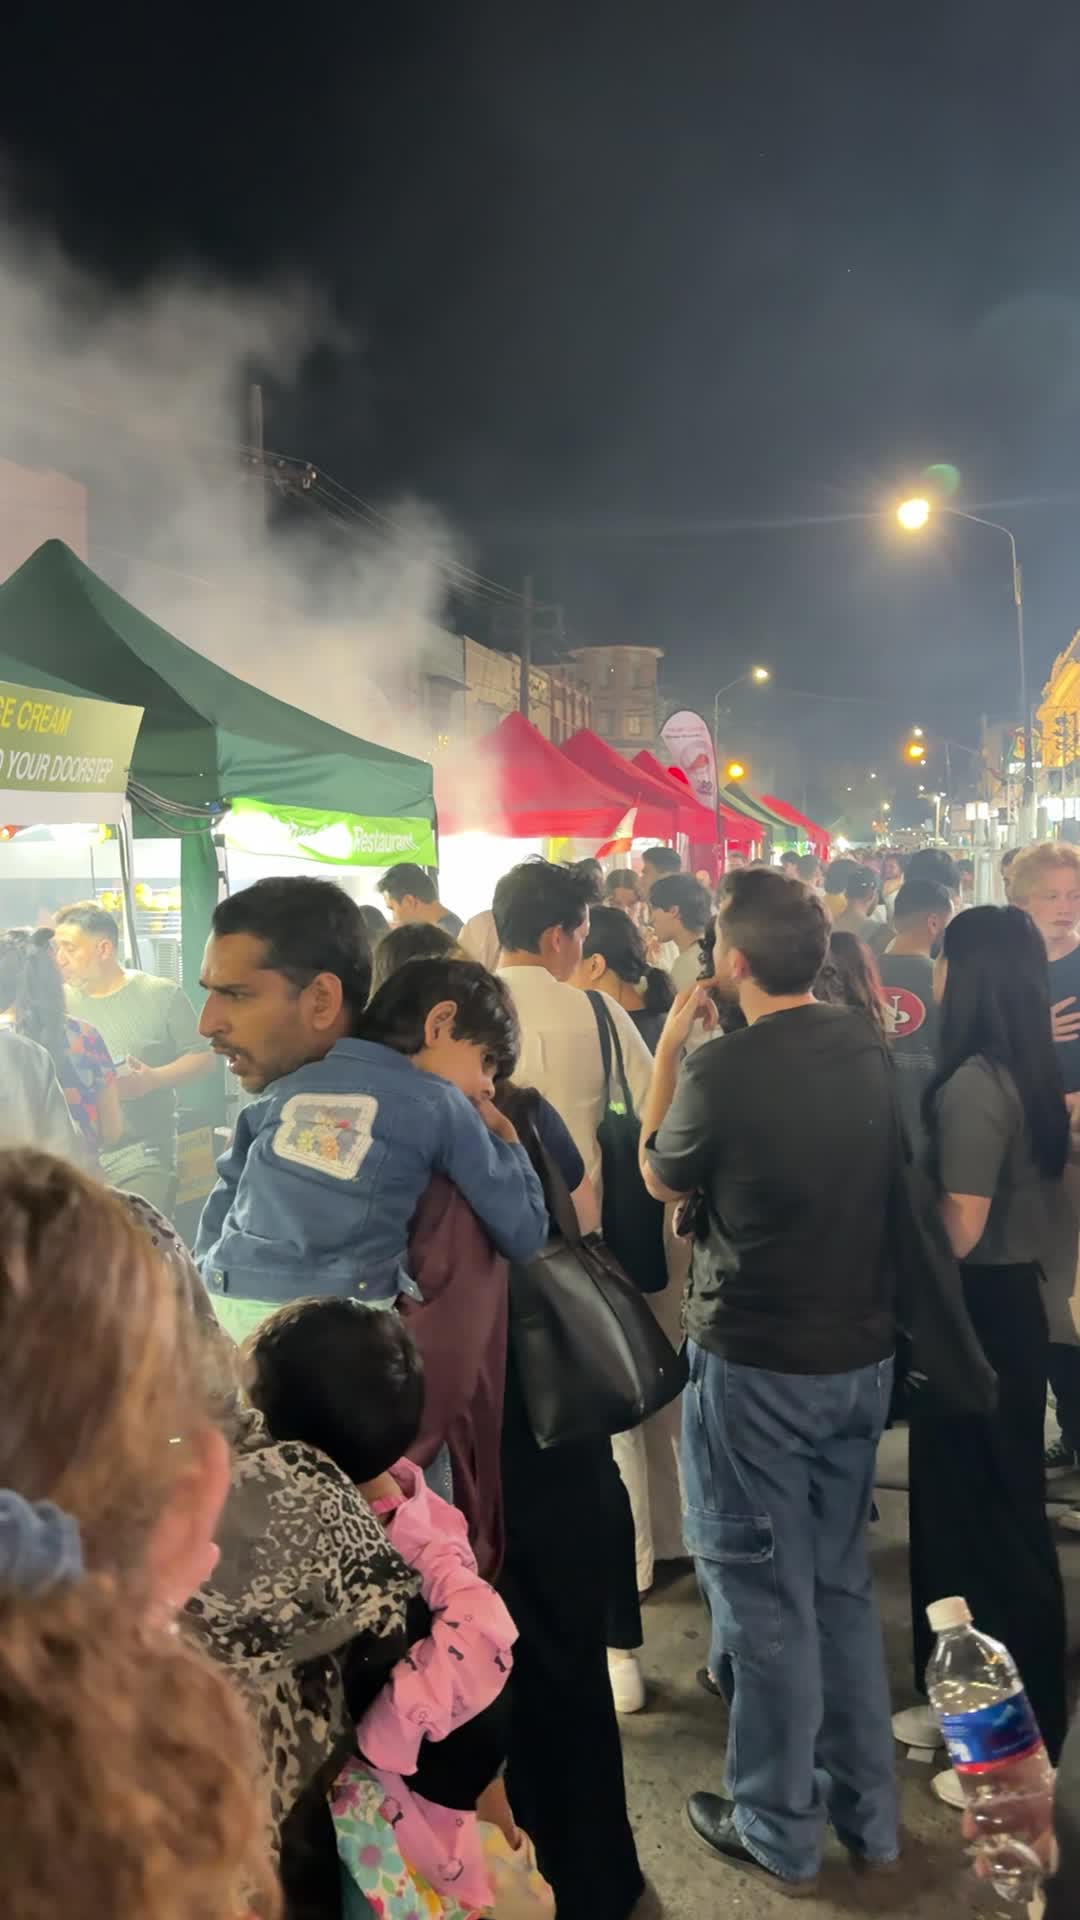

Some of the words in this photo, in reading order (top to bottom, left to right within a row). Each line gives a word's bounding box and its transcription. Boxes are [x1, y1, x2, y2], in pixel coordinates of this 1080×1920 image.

[17, 700, 72, 736] CREAM
[7, 750, 50, 781] YOUR
[49, 755, 113, 783] DOORSTEP
